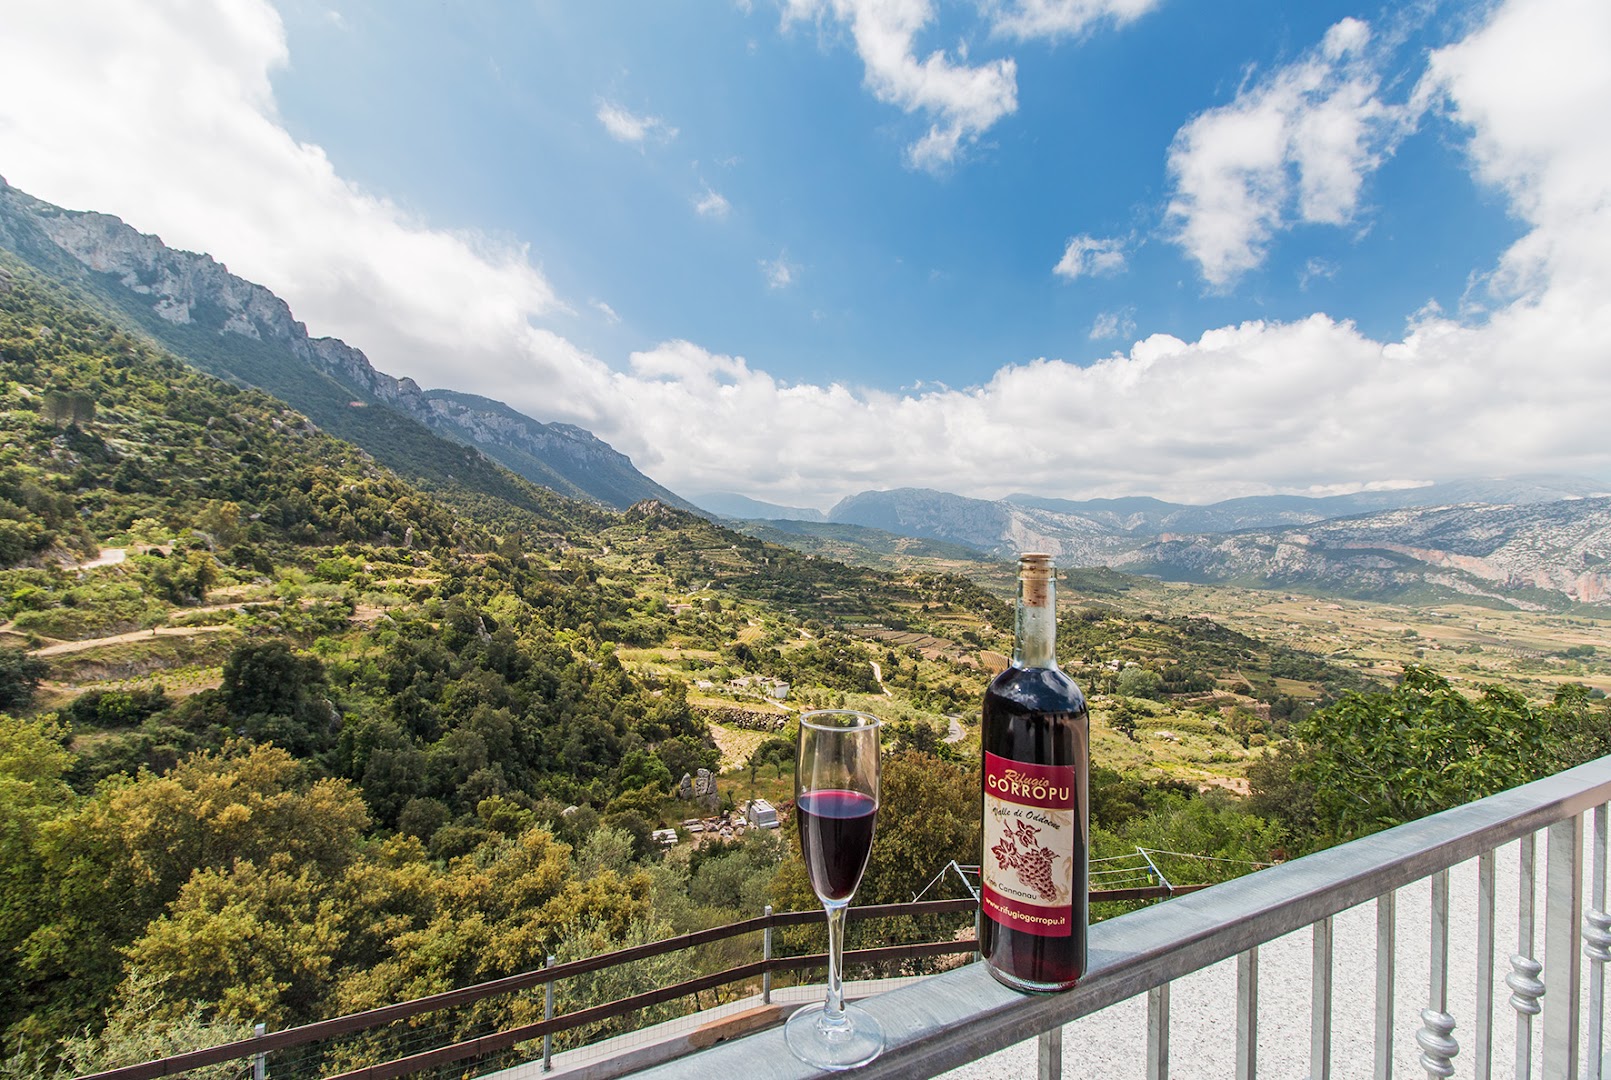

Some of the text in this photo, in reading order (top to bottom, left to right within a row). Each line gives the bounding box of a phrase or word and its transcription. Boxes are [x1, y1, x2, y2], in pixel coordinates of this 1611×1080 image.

[988, 774, 1069, 801] GORROPU
[1004, 769, 1049, 790] Rifugio
[1013, 809, 1022, 818] di
[998, 882, 1038, 900] Cannonau
[985, 896, 1066, 927] www.rifugiogorropu.it
